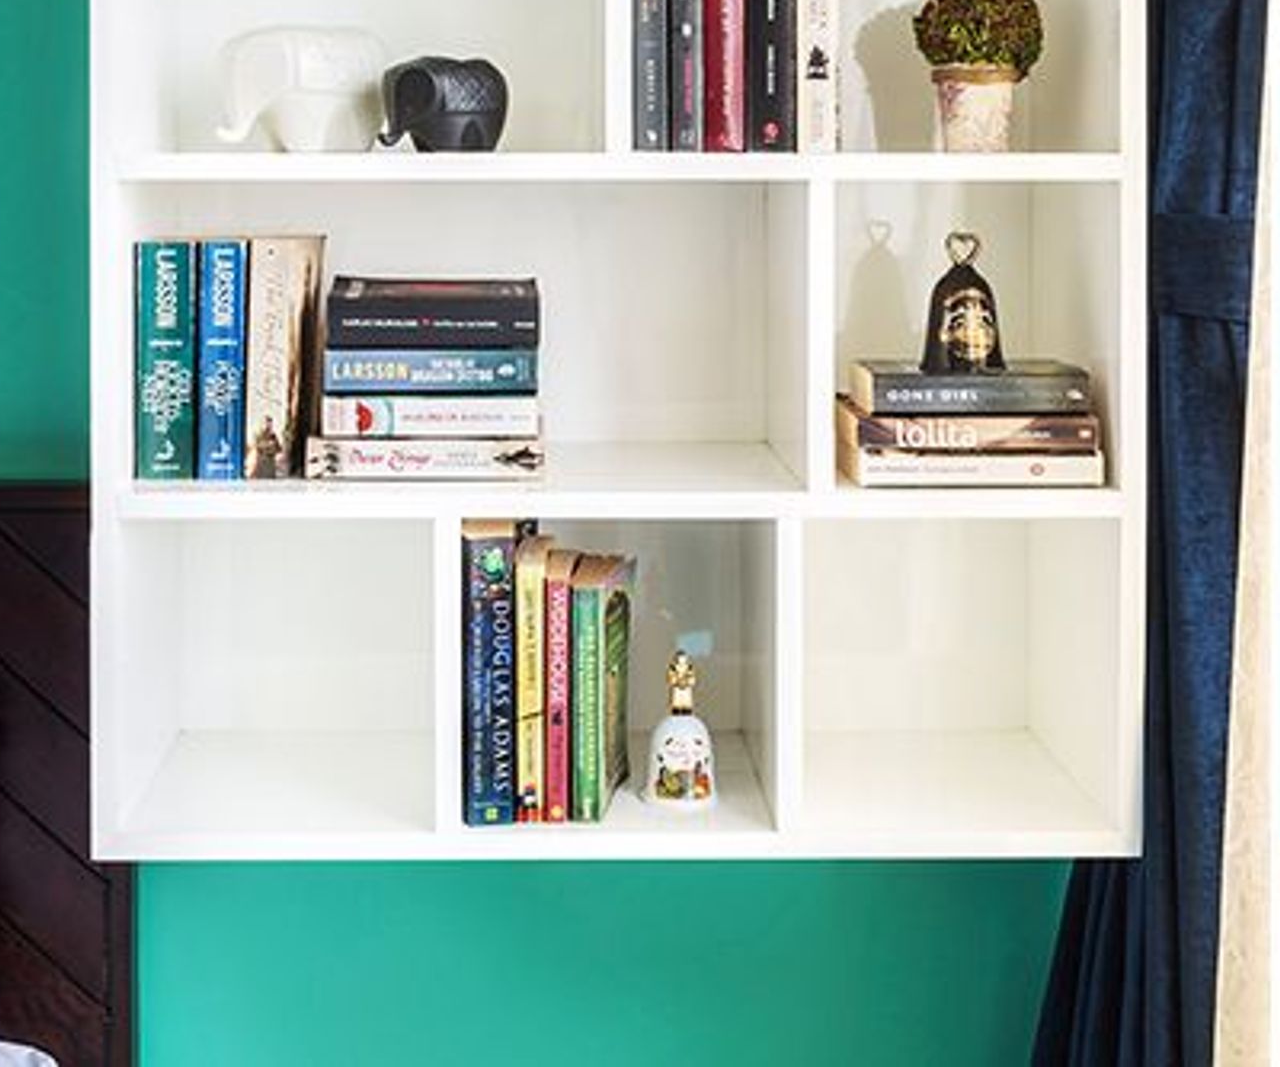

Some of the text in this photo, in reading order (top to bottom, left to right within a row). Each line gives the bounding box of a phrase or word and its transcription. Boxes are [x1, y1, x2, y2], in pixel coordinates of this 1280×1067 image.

[156, 249, 176, 327] LARSSON
[213, 248, 234, 325] LARSSON
[332, 362, 409, 381] LARSSON
[886, 389, 978, 401] GONE GIRL
[895, 421, 978, 448] lolita
[492, 600, 511, 792] DOUGLAS ADAMS
